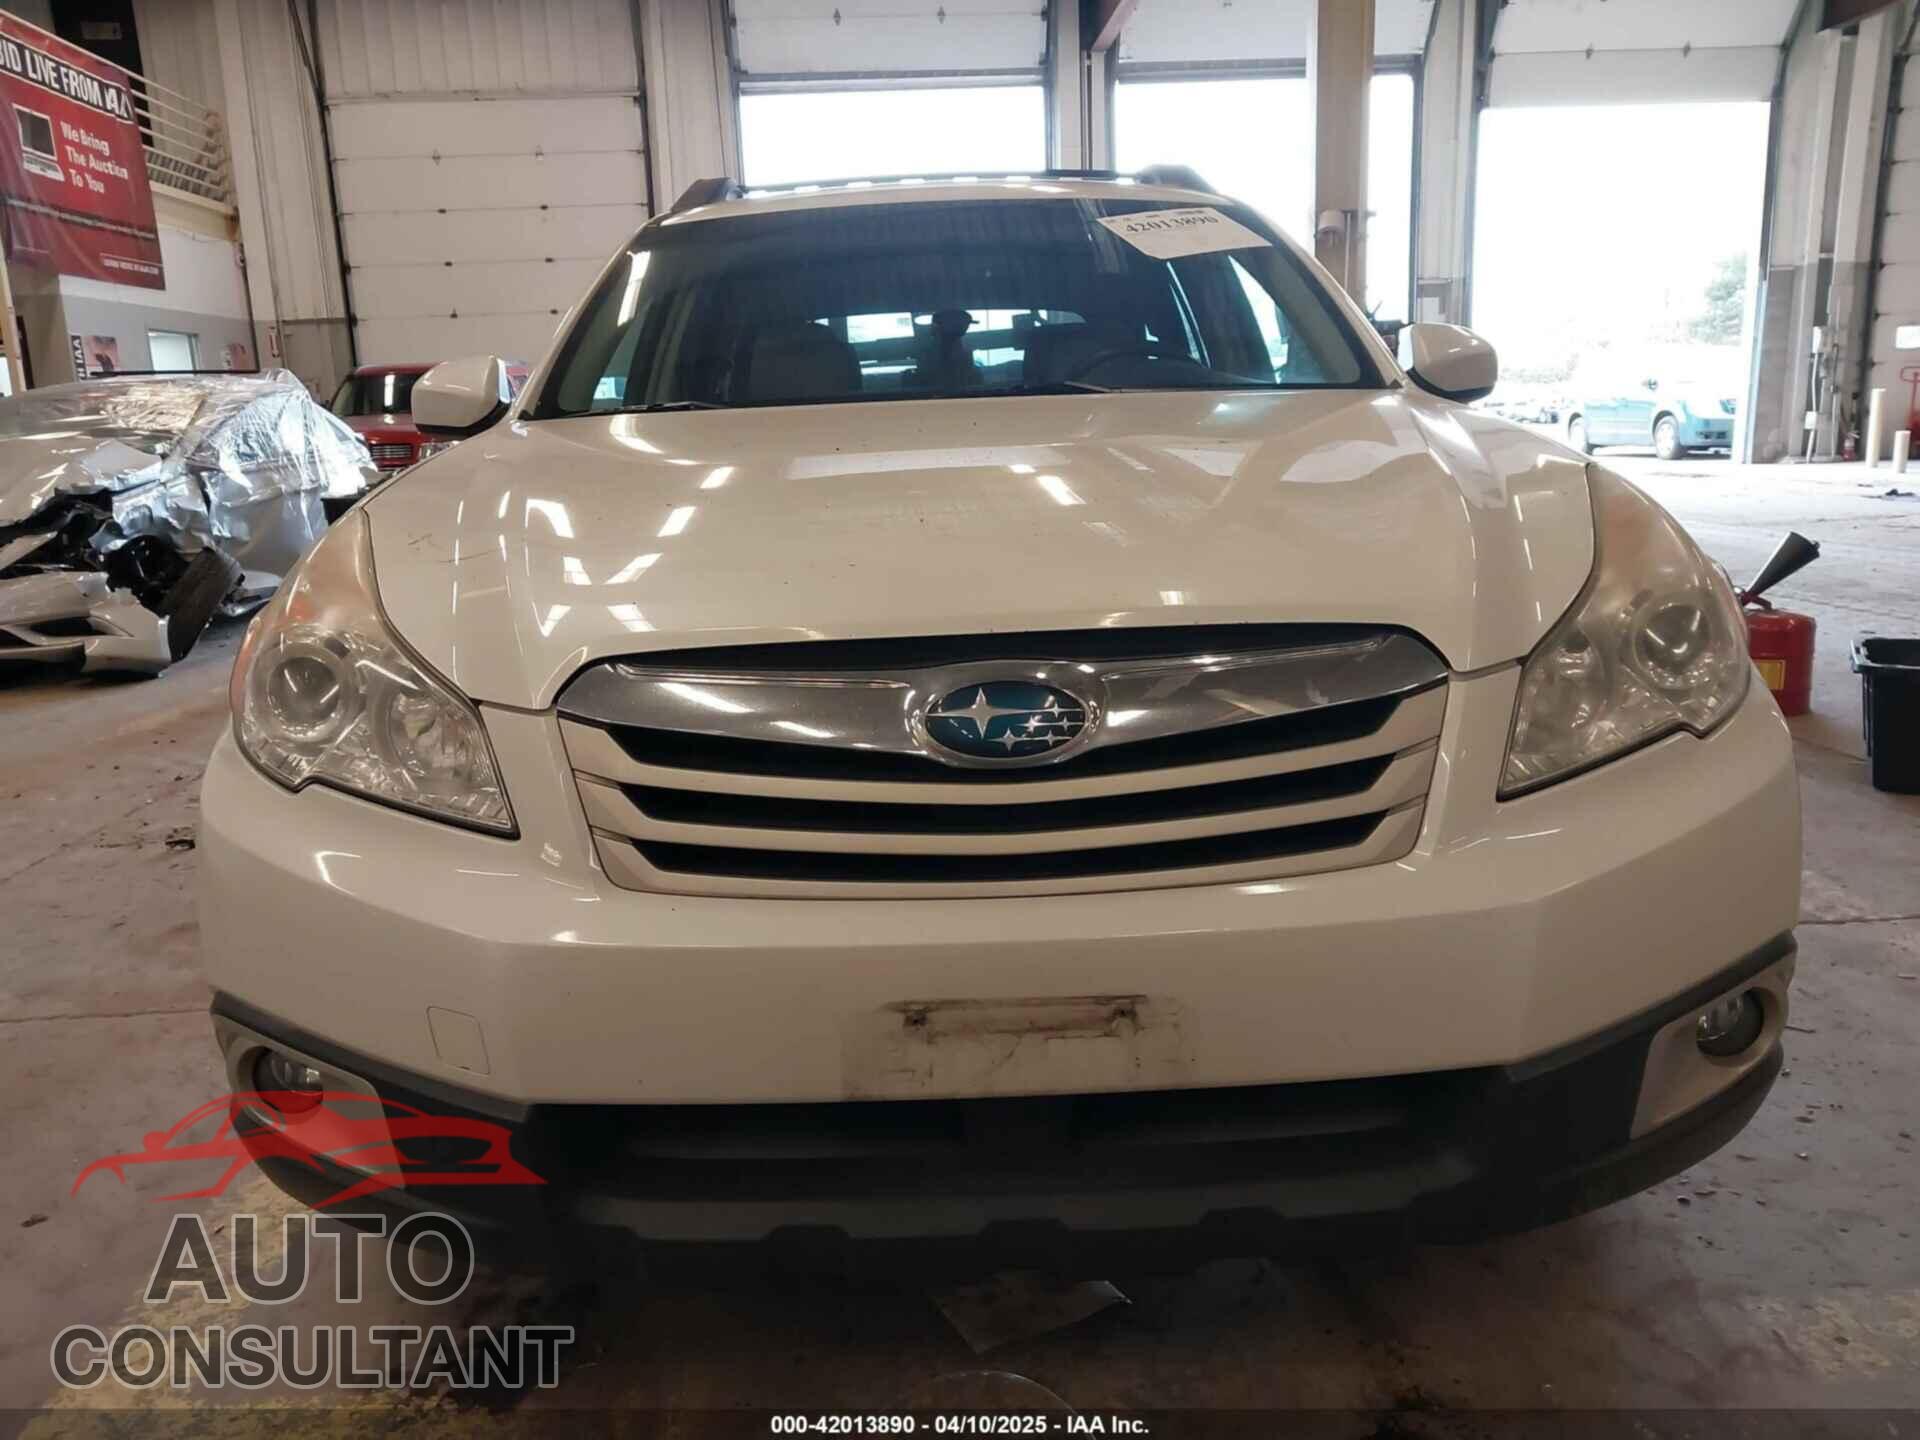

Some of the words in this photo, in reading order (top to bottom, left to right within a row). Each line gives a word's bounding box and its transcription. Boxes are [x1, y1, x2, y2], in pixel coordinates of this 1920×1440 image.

[24, 49, 60, 89] LIVE
[59, 65, 104, 107] FROM
[60, 120, 80, 143] We
[79, 128, 110, 157] Bring
[64, 144, 87, 167] The
[88, 153, 129, 180] Auction
[68, 168, 84, 188] To
[84, 171, 105, 195] You
